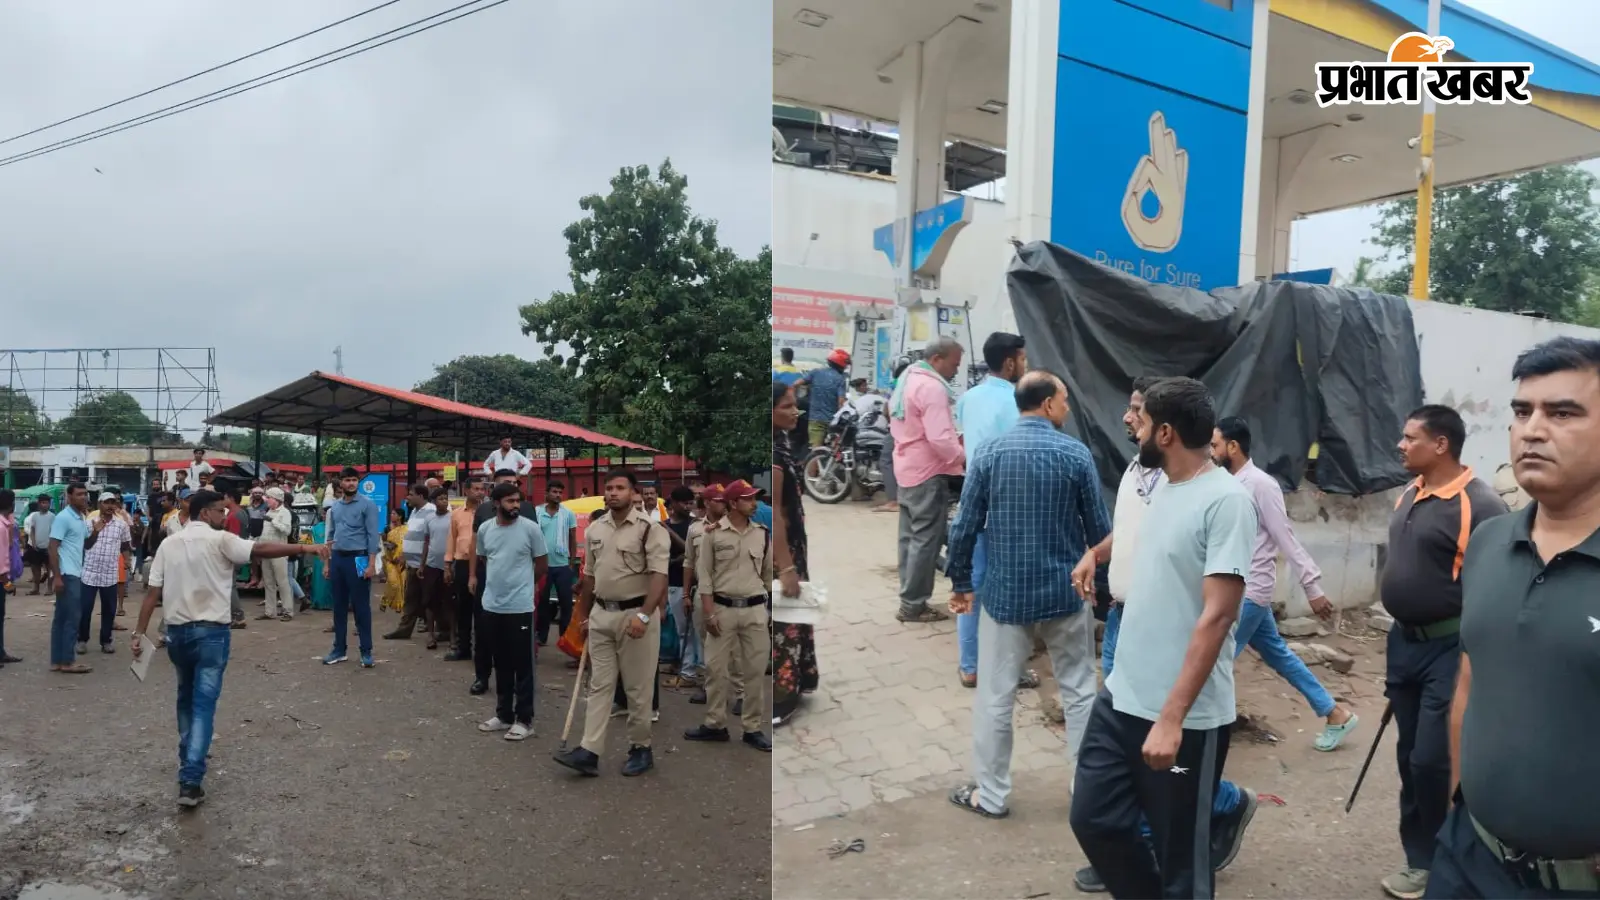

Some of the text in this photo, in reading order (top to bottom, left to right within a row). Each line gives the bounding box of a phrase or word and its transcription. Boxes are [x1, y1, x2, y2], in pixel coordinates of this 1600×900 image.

[1095, 250, 1202, 289] Pure for Sure
